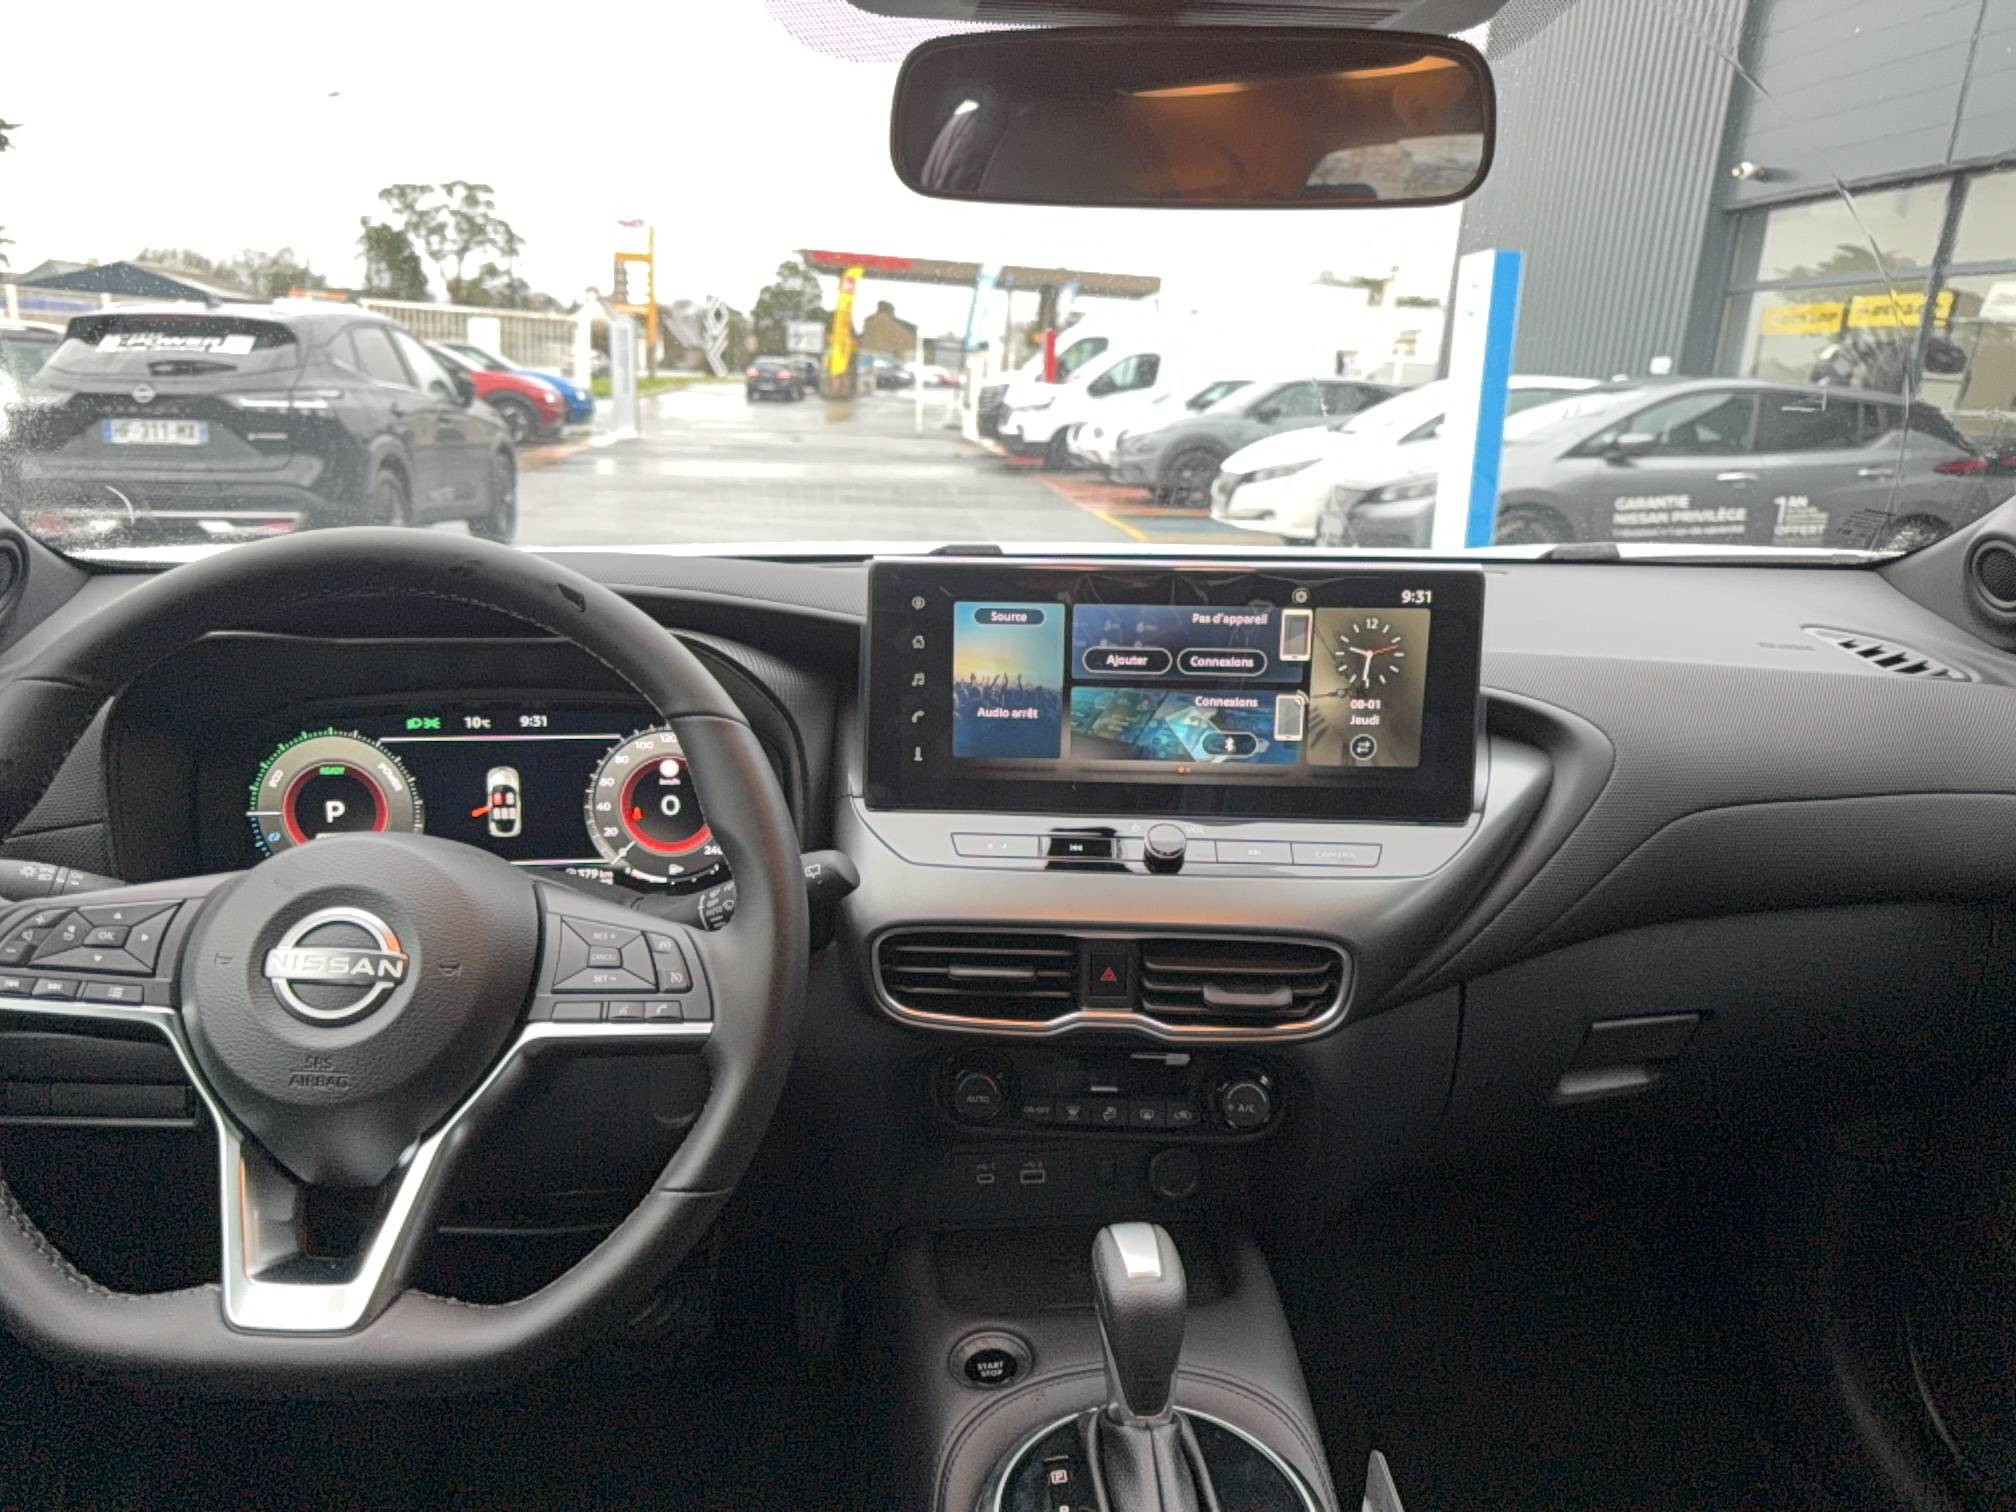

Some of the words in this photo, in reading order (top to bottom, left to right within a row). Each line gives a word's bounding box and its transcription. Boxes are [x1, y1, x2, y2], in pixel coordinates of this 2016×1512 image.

[1614, 495, 1690, 511] GARANTIE
[1613, 511, 1669, 525] NISSAN
[1401, 589, 1432, 604] 9:31
[991, 610, 1028, 622] Source
[1192, 612, 1211, 624] Pas
[1366, 618, 1380, 629] 12
[1106, 653, 1149, 668] Ajouter
[1189, 654, 1254, 668] Connexions
[1195, 695, 1258, 709] Connexions
[976, 706, 1010, 719] Audio
[1011, 706, 1039, 720] arrêt
[1349, 713, 1380, 727] Jeudi
[519, 714, 548, 728] 9:31
[634, 740, 654, 751] 100
[613, 754, 630, 765] 80
[599, 776, 616, 787] 60
[324, 800, 346, 824] P
[595, 801, 612, 812] 40
[660, 794, 681, 816] 0
[602, 825, 619, 838] 20
[270, 953, 404, 978] NISSAN
[977, 1361, 1004, 1370] START
